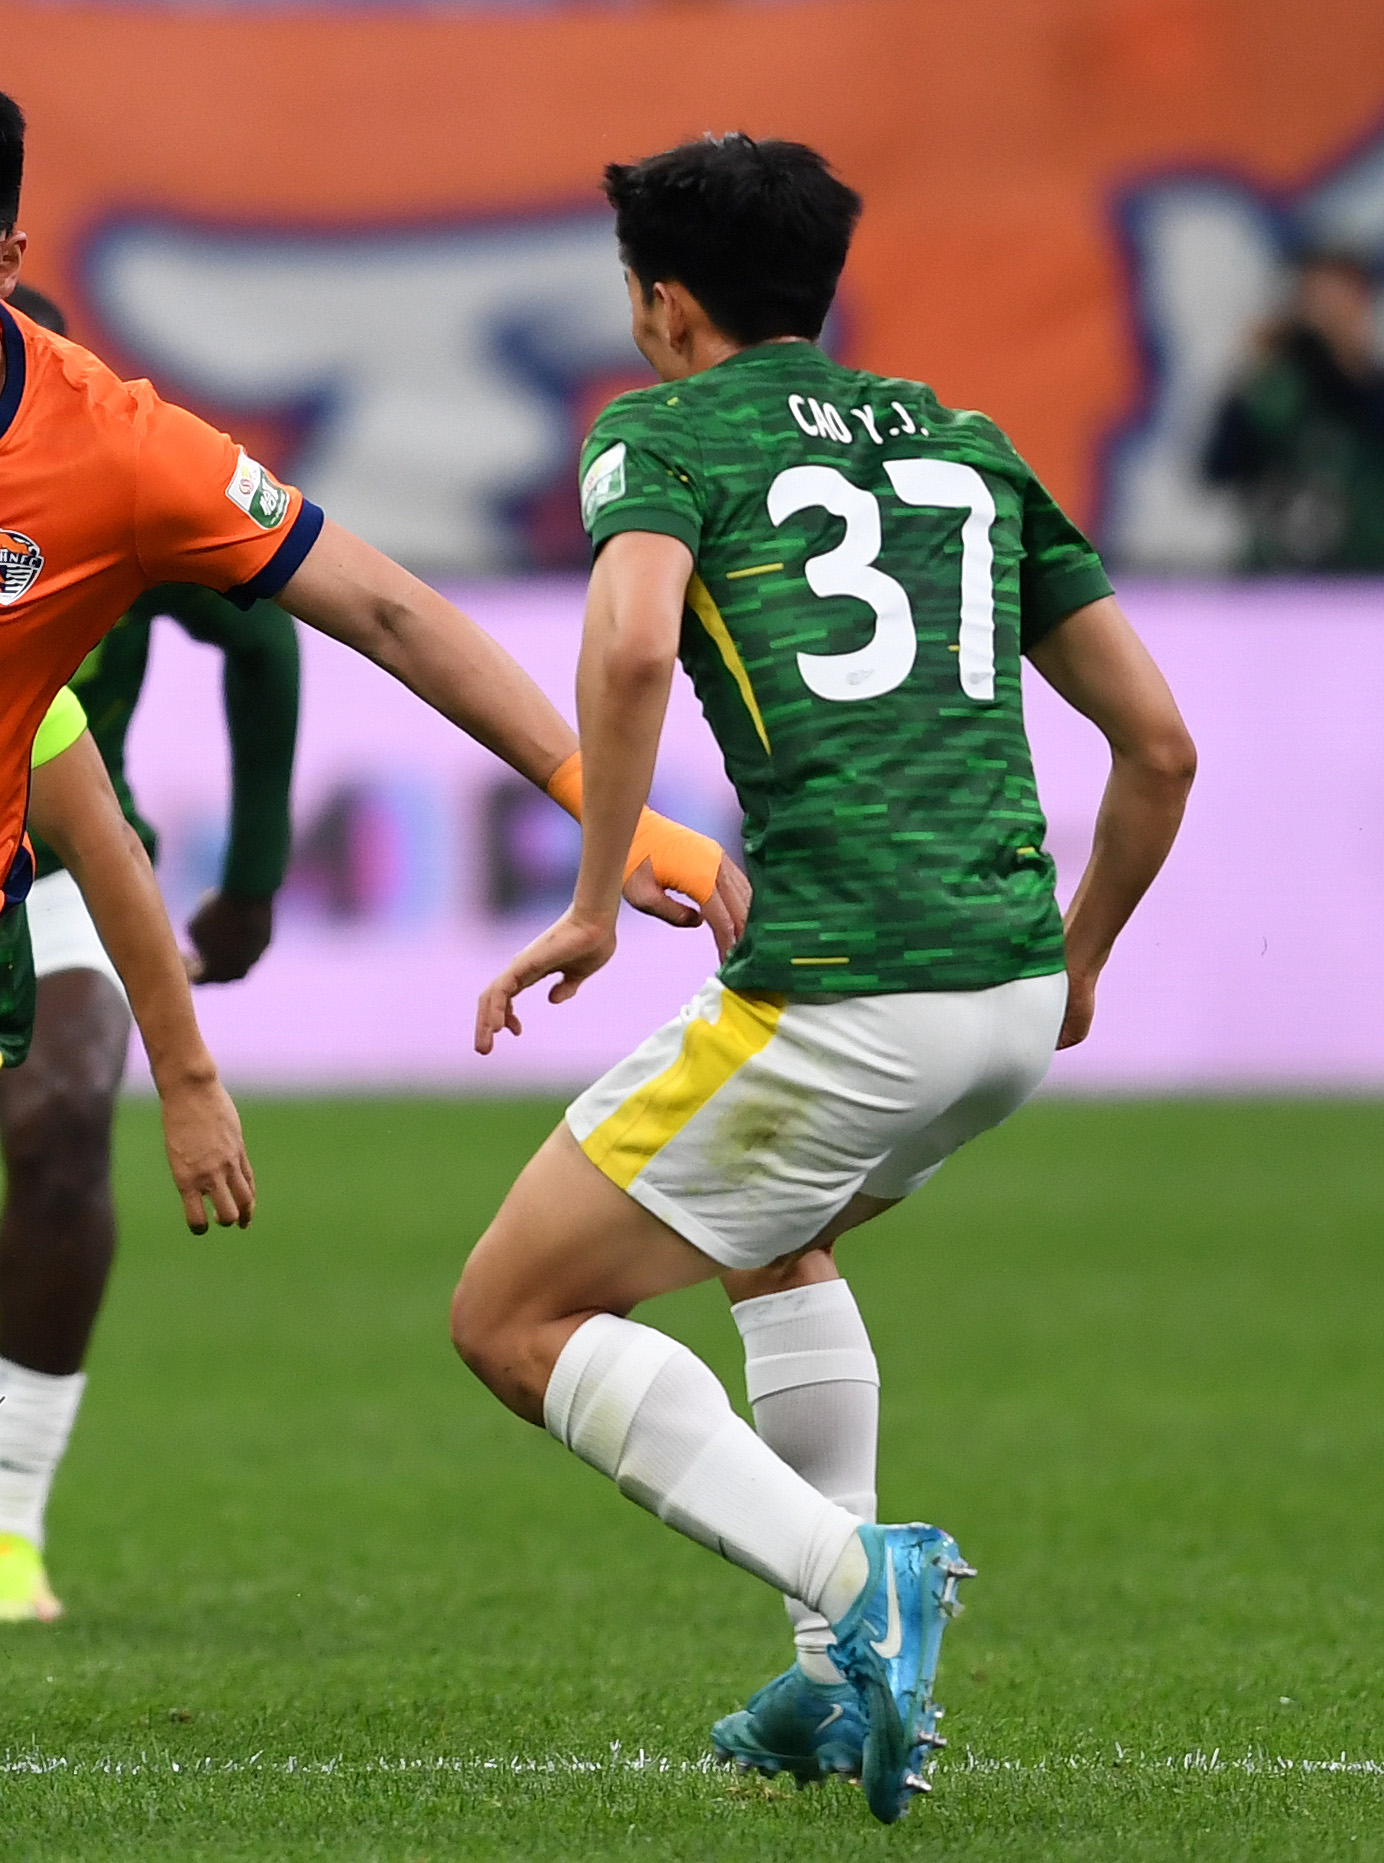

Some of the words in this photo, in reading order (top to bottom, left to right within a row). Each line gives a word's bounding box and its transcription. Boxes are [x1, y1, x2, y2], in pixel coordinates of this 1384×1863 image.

[788, 394, 852, 444] CAO
[850, 401, 929, 445] Y.J.
[766, 458, 996, 701] 37
